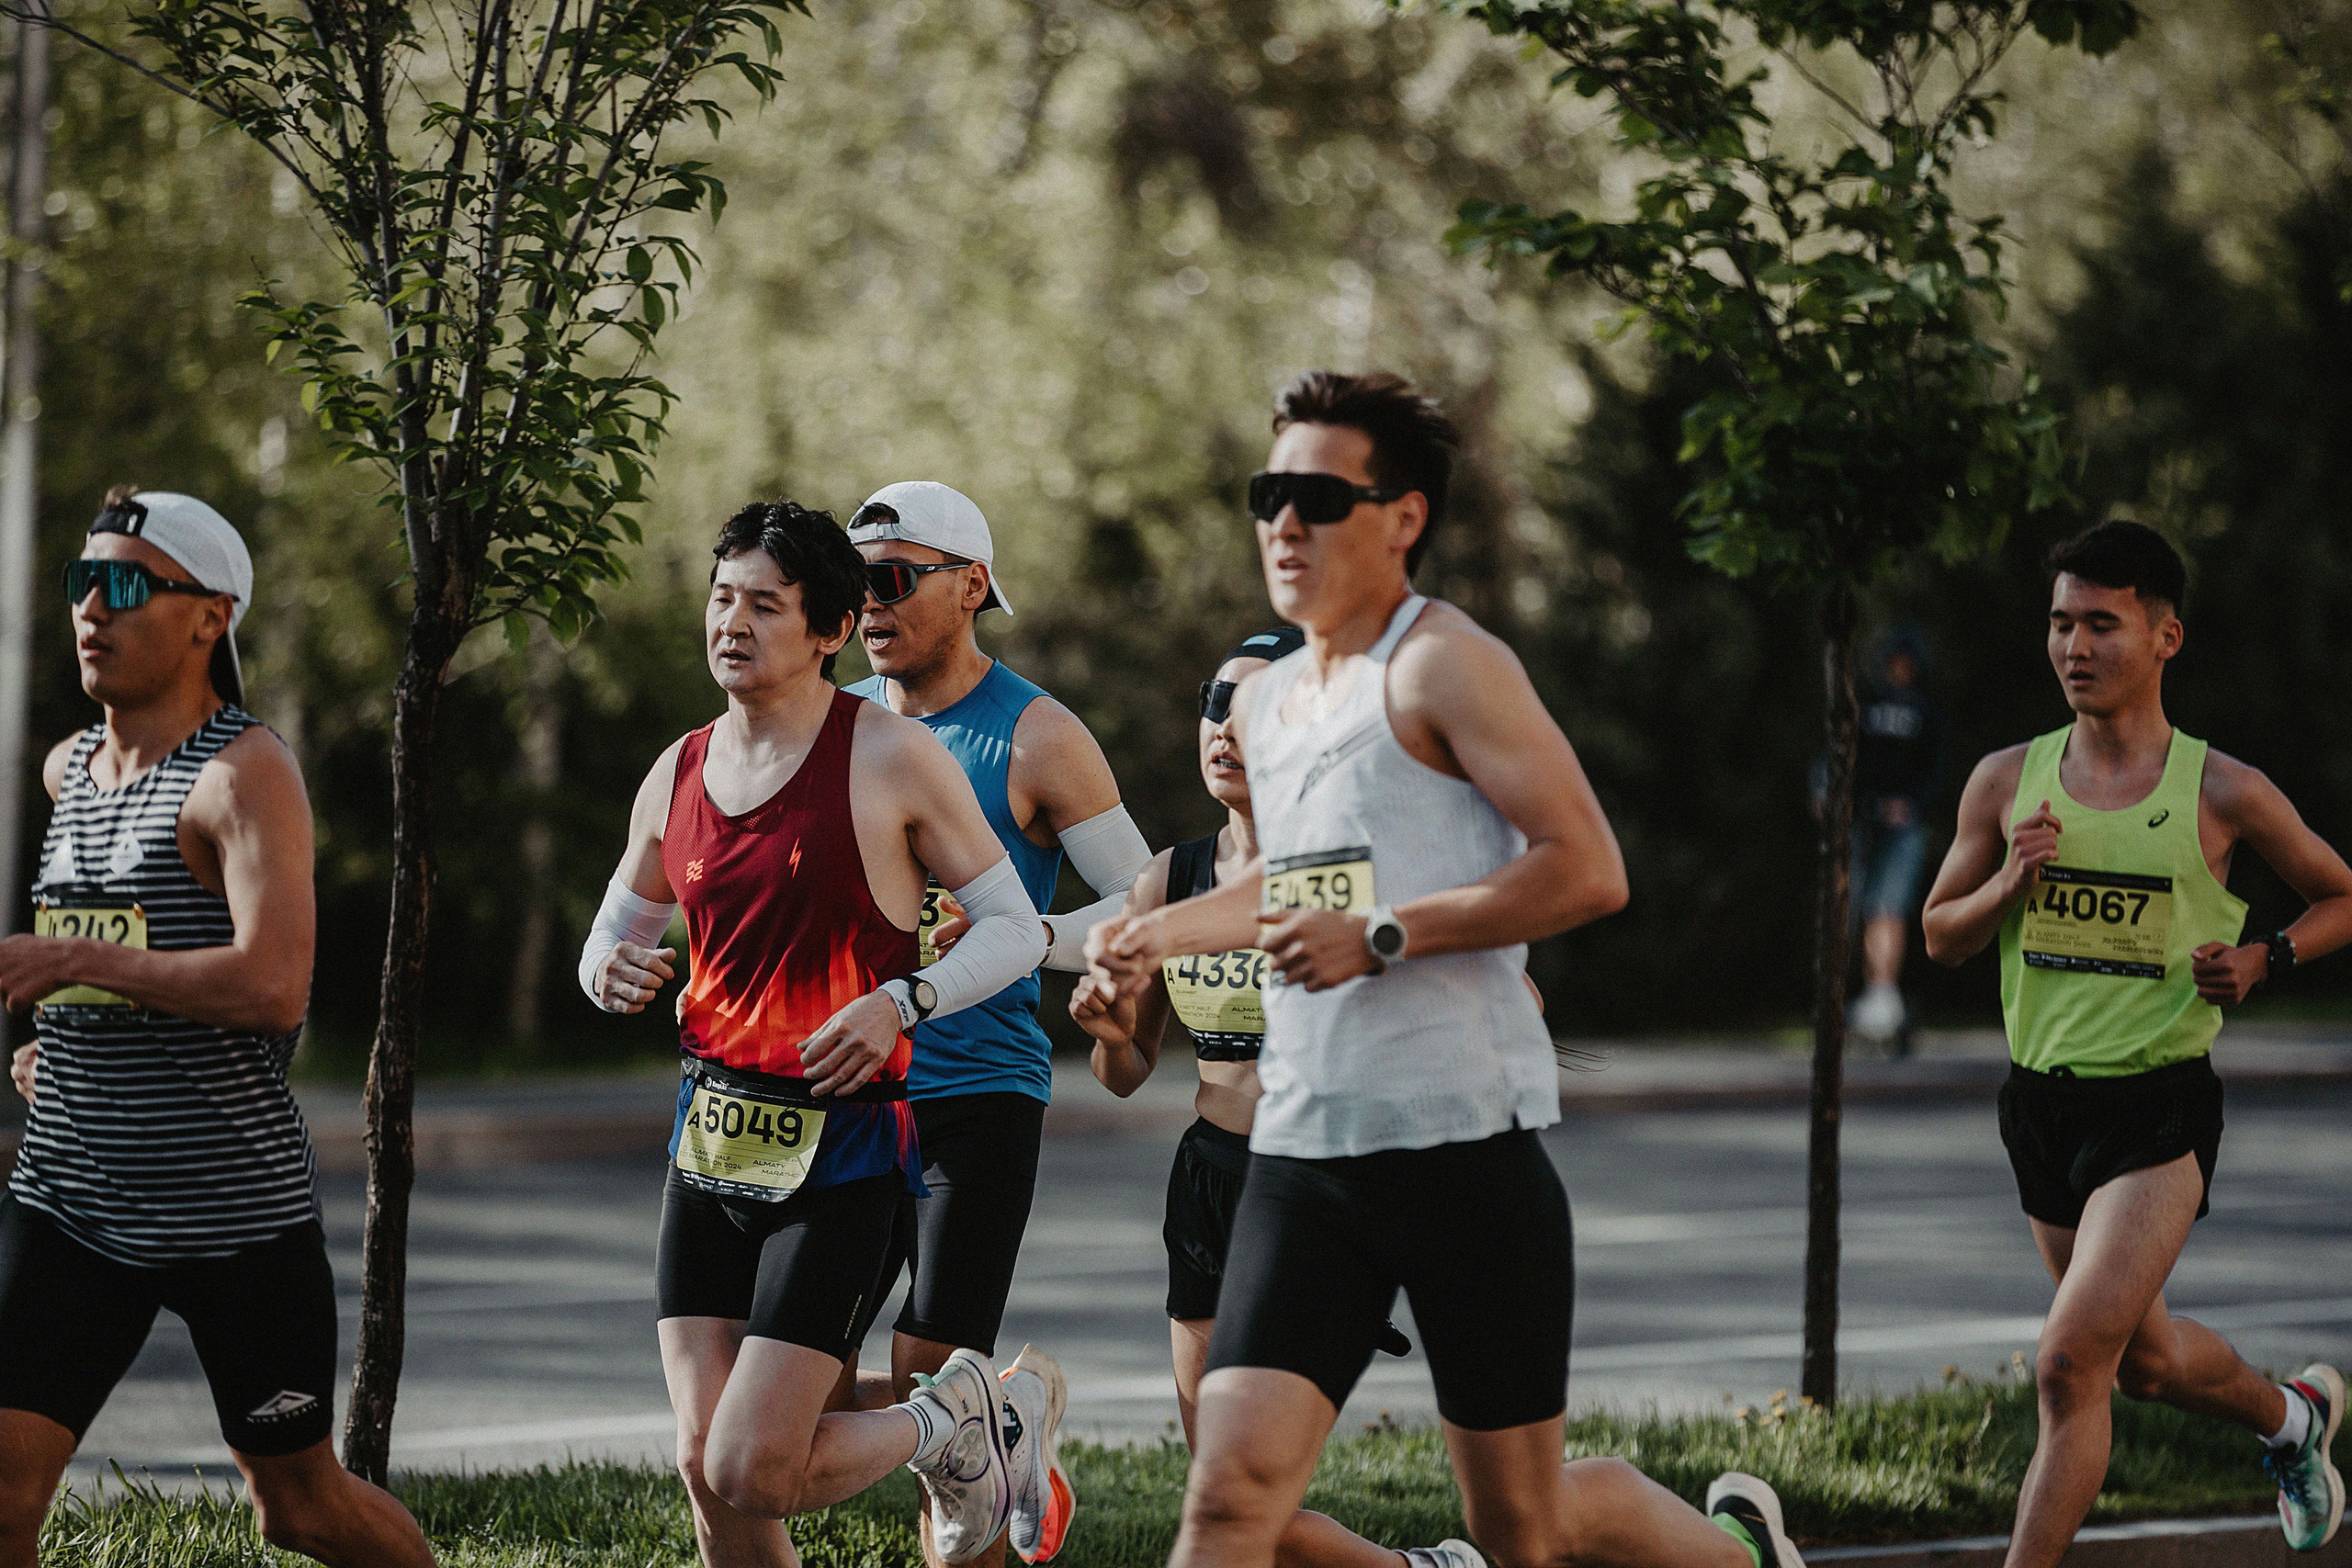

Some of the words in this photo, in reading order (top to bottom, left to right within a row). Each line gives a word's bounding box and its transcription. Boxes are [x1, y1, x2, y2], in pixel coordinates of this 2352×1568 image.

[2028, 897, 2038, 914] A
[2043, 883, 2150, 926] 4067
[1167, 967, 1175, 985] A
[1178, 951, 1268, 990] 4336
[687, 1111, 700, 1129] A
[704, 1095, 804, 1148] 5049
[723, 1162, 742, 1170] 2024
[752, 1159, 786, 1169] ALMATY
